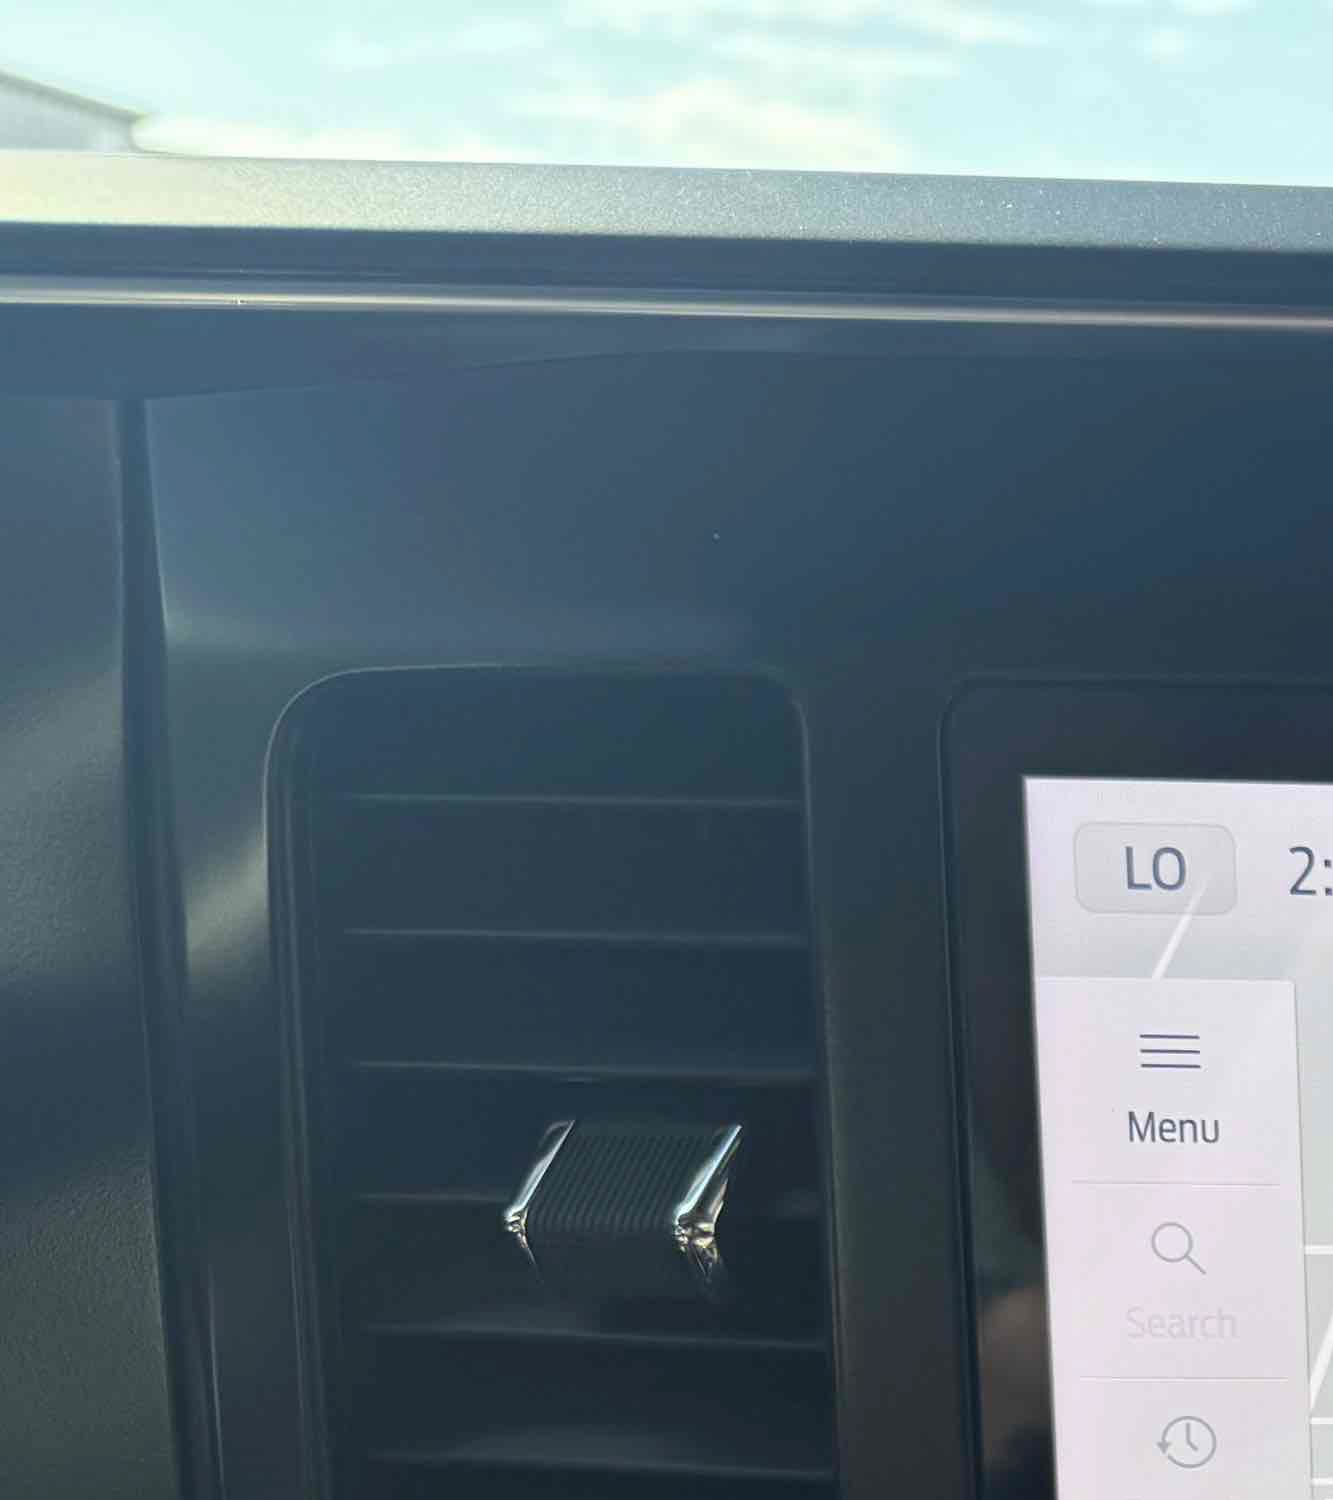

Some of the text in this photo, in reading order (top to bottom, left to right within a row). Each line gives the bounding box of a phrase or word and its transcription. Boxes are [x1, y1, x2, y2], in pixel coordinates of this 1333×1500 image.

[1125, 846, 1186, 892] LO
[1127, 1111, 1220, 1145] Menu
[1126, 1307, 1237, 1341] Search
